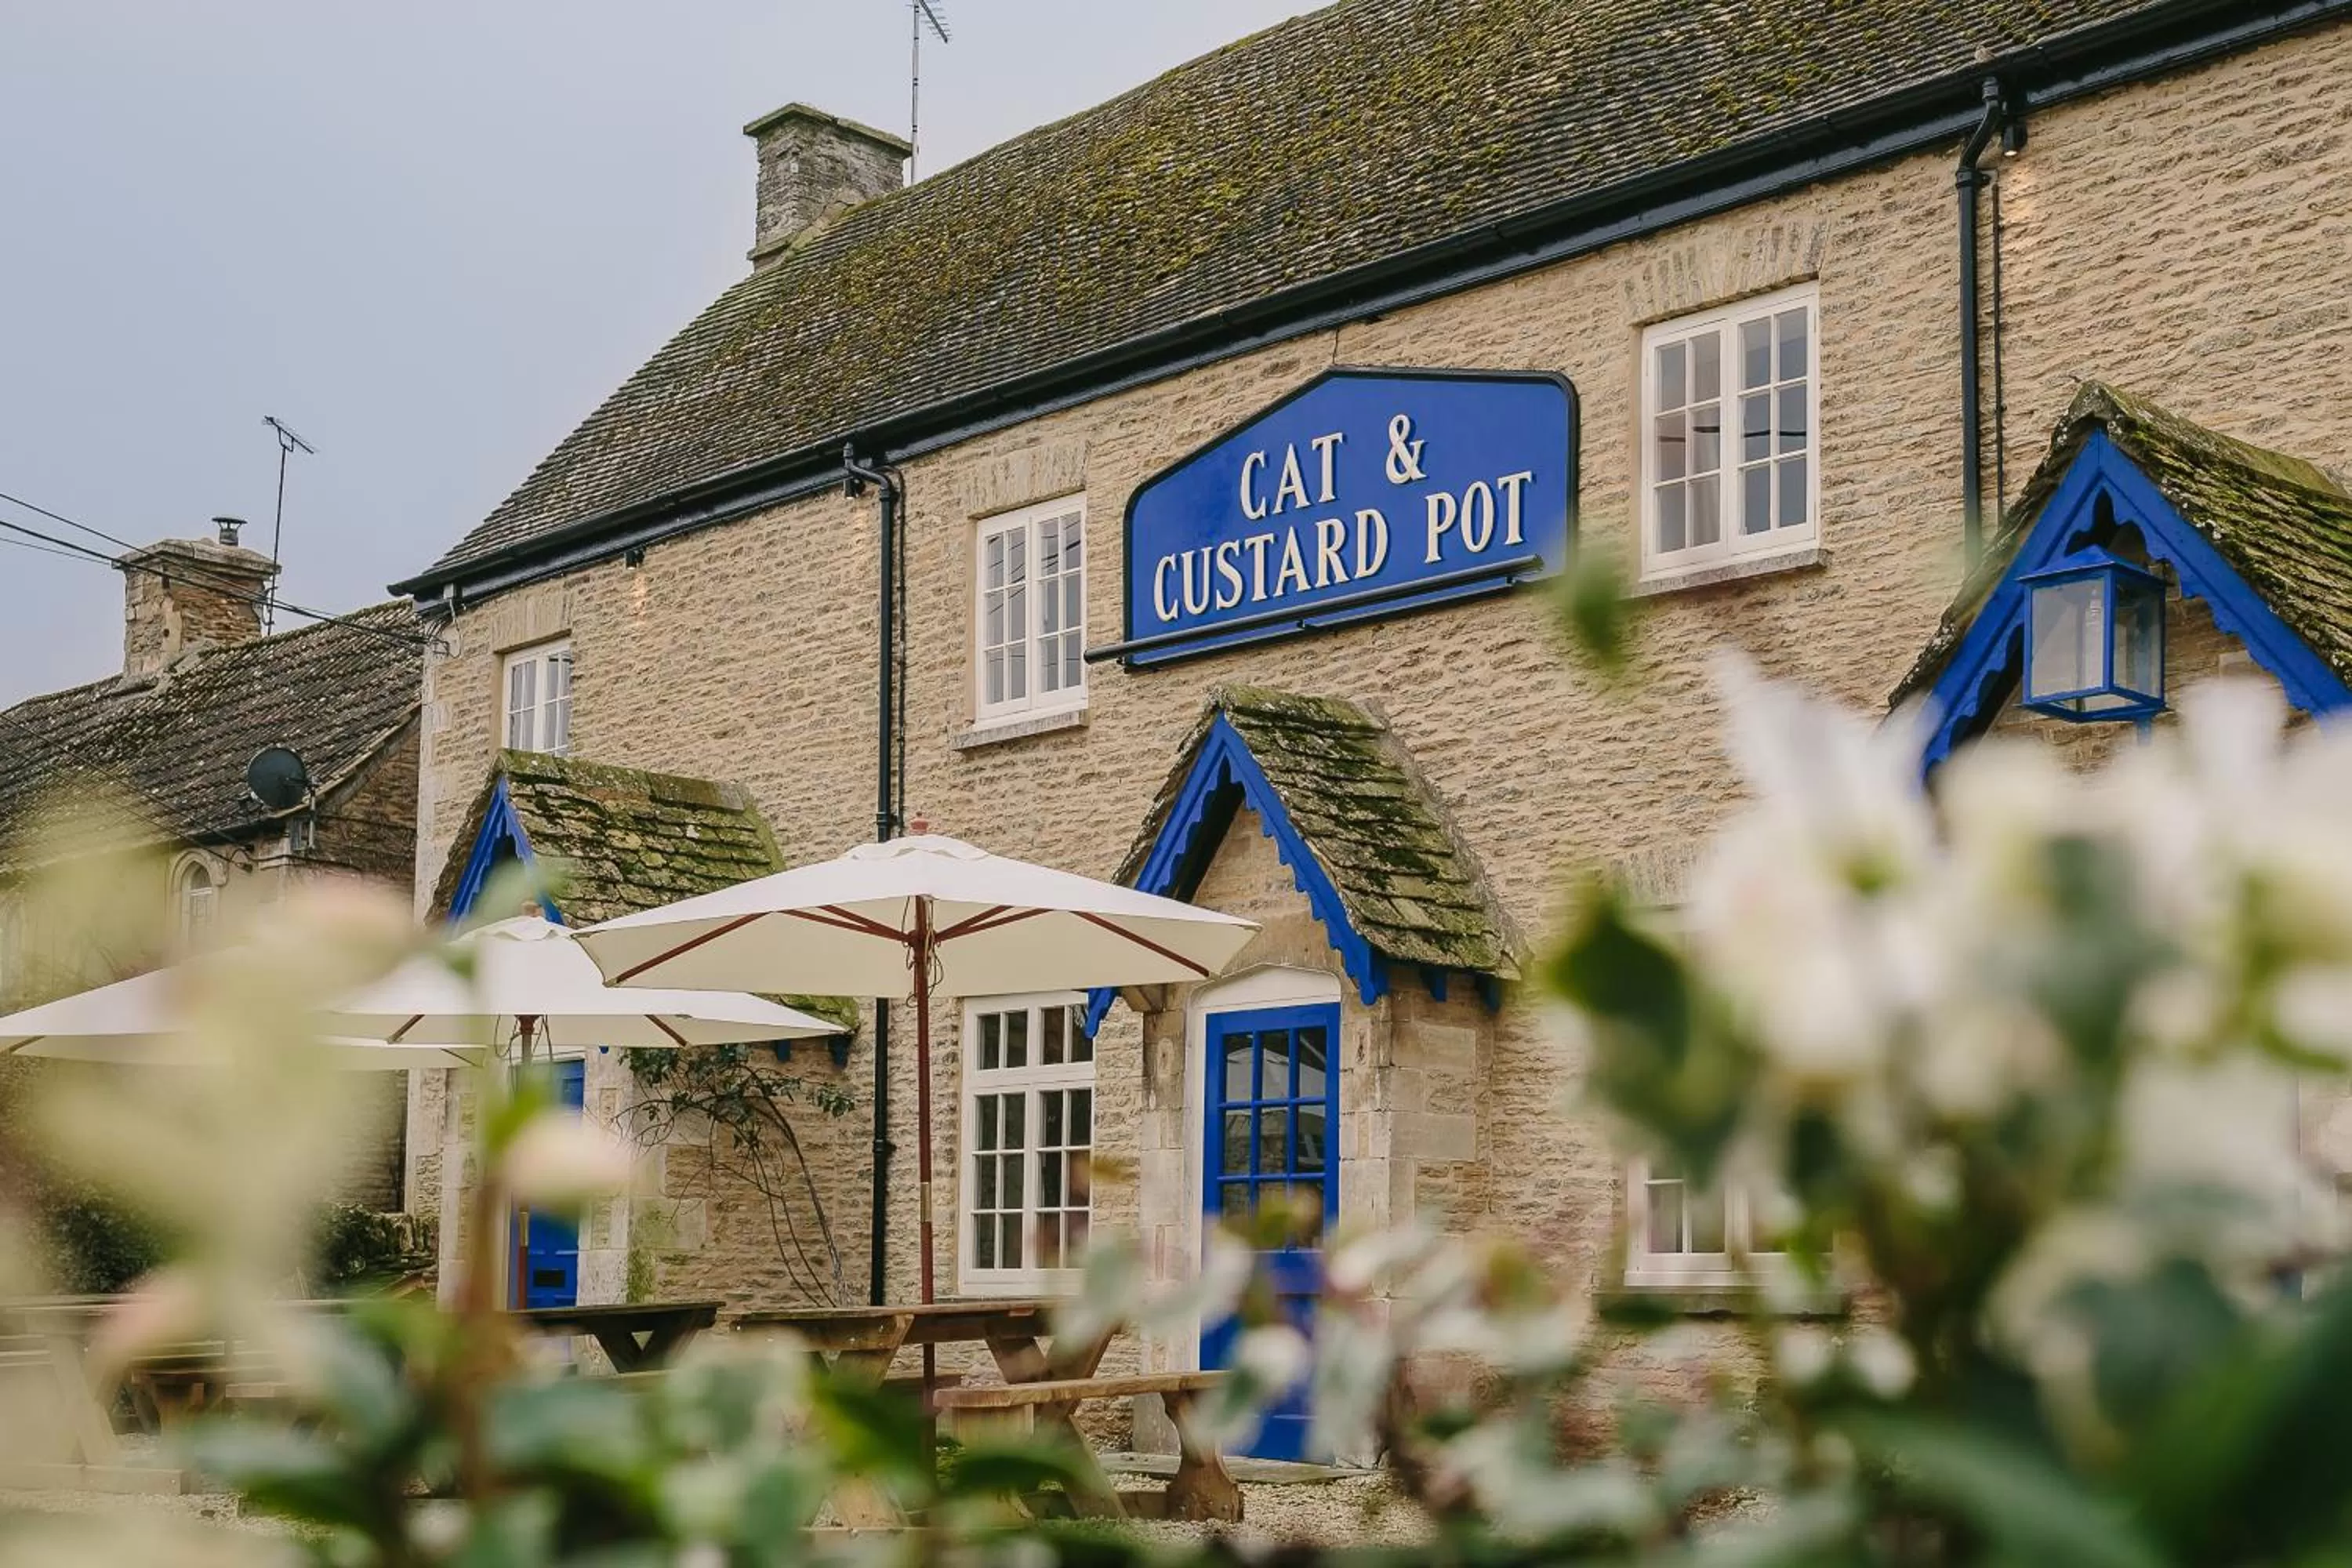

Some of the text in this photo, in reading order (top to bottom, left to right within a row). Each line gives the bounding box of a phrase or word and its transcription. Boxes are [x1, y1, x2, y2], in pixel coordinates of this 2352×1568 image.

[1240, 414, 1426, 520] CAT &
[1153, 470, 1531, 621] CUSTARD POT
